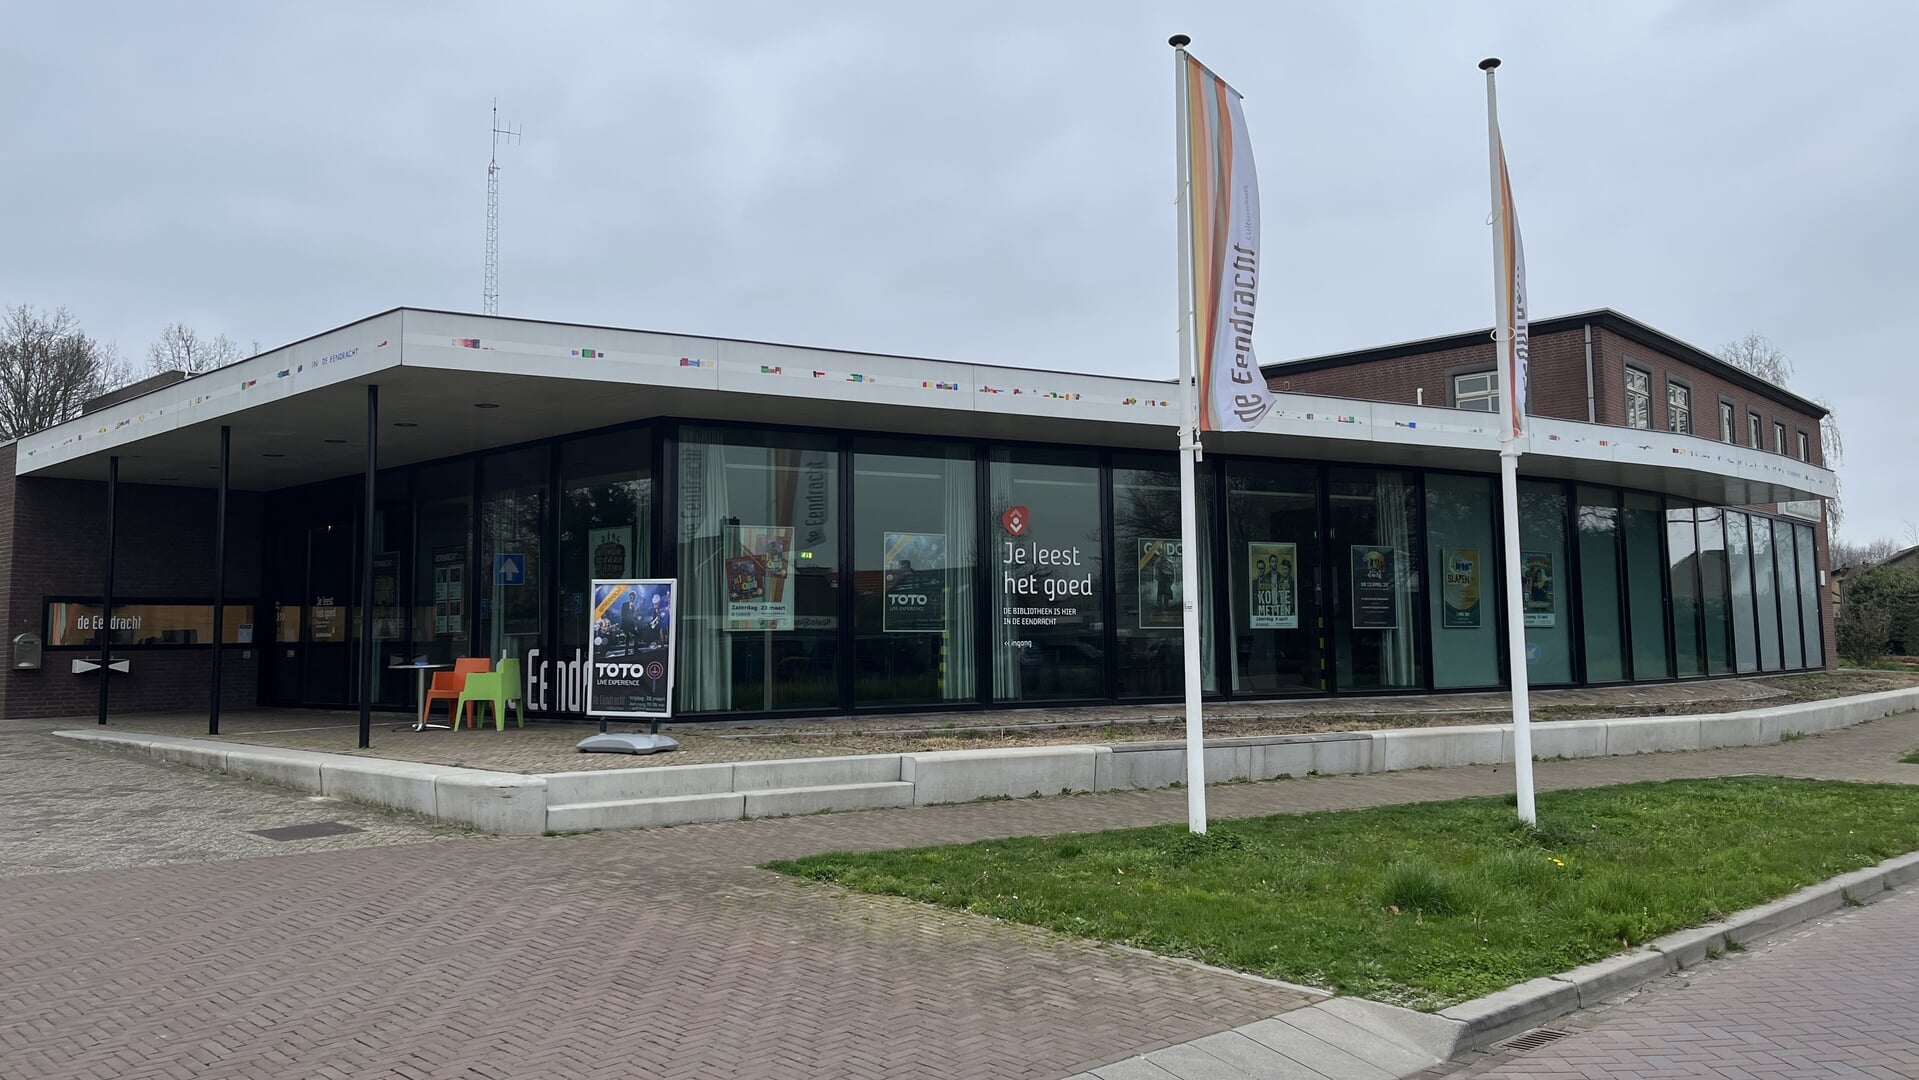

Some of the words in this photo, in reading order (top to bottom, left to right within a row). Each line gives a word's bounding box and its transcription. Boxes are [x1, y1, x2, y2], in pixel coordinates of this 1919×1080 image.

[1229, 242, 1256, 385] Eendracht
[311, 360, 319, 369] IN
[321, 357, 328, 365] DE
[329, 347, 359, 364] EENDRACHT
[1234, 393, 1267, 424] de
[805, 461, 825, 527] Eendracht
[1003, 542, 1026, 564] Je
[1033, 542, 1081, 566] leest
[1004, 571, 1038, 595] het
[1044, 573, 1093, 602] goed
[888, 594, 928, 605] TOTO
[1003, 607, 1011, 615] DE
[1012, 607, 1053, 615] BIBLIOTHEEK
[1061, 608, 1077, 616] HIER
[77, 615, 90, 630] de
[92, 615, 142, 630] Eedracht
[1021, 618, 1057, 626] EENDRACHT
[1011, 640, 1032, 648] ingang
[595, 663, 645, 678] TOTO
